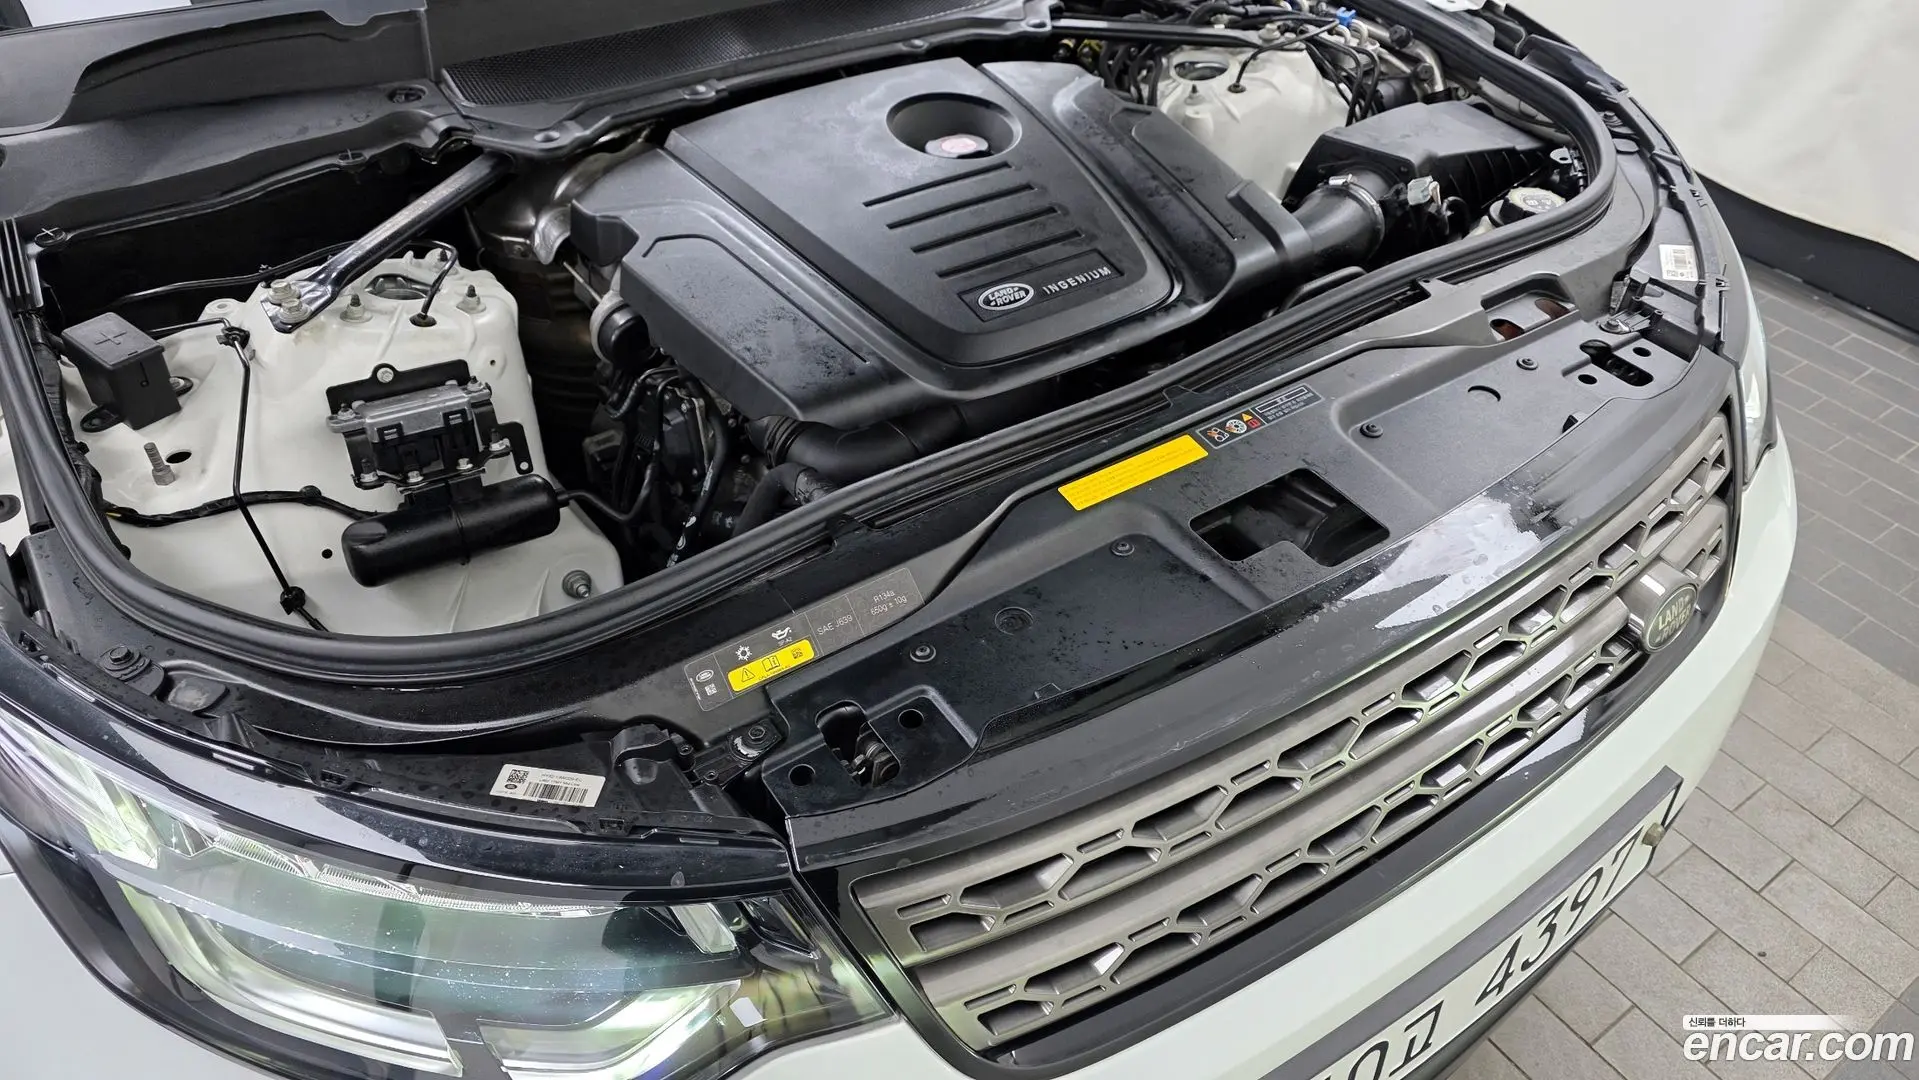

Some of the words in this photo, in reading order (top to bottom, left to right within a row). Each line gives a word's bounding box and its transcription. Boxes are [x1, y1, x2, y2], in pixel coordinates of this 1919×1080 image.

[1042, 266, 1112, 294] INGENIUM
[988, 286, 1014, 300] LAND
[995, 290, 1027, 307] ROVER
[870, 603, 888, 616] 650g
[894, 595, 907, 607] 10g
[873, 590, 895, 603] R134a
[1658, 596, 1686, 630] LAND
[816, 622, 834, 635] SAE
[835, 614, 853, 628] J639
[1475, 825, 1644, 1006] 4397
